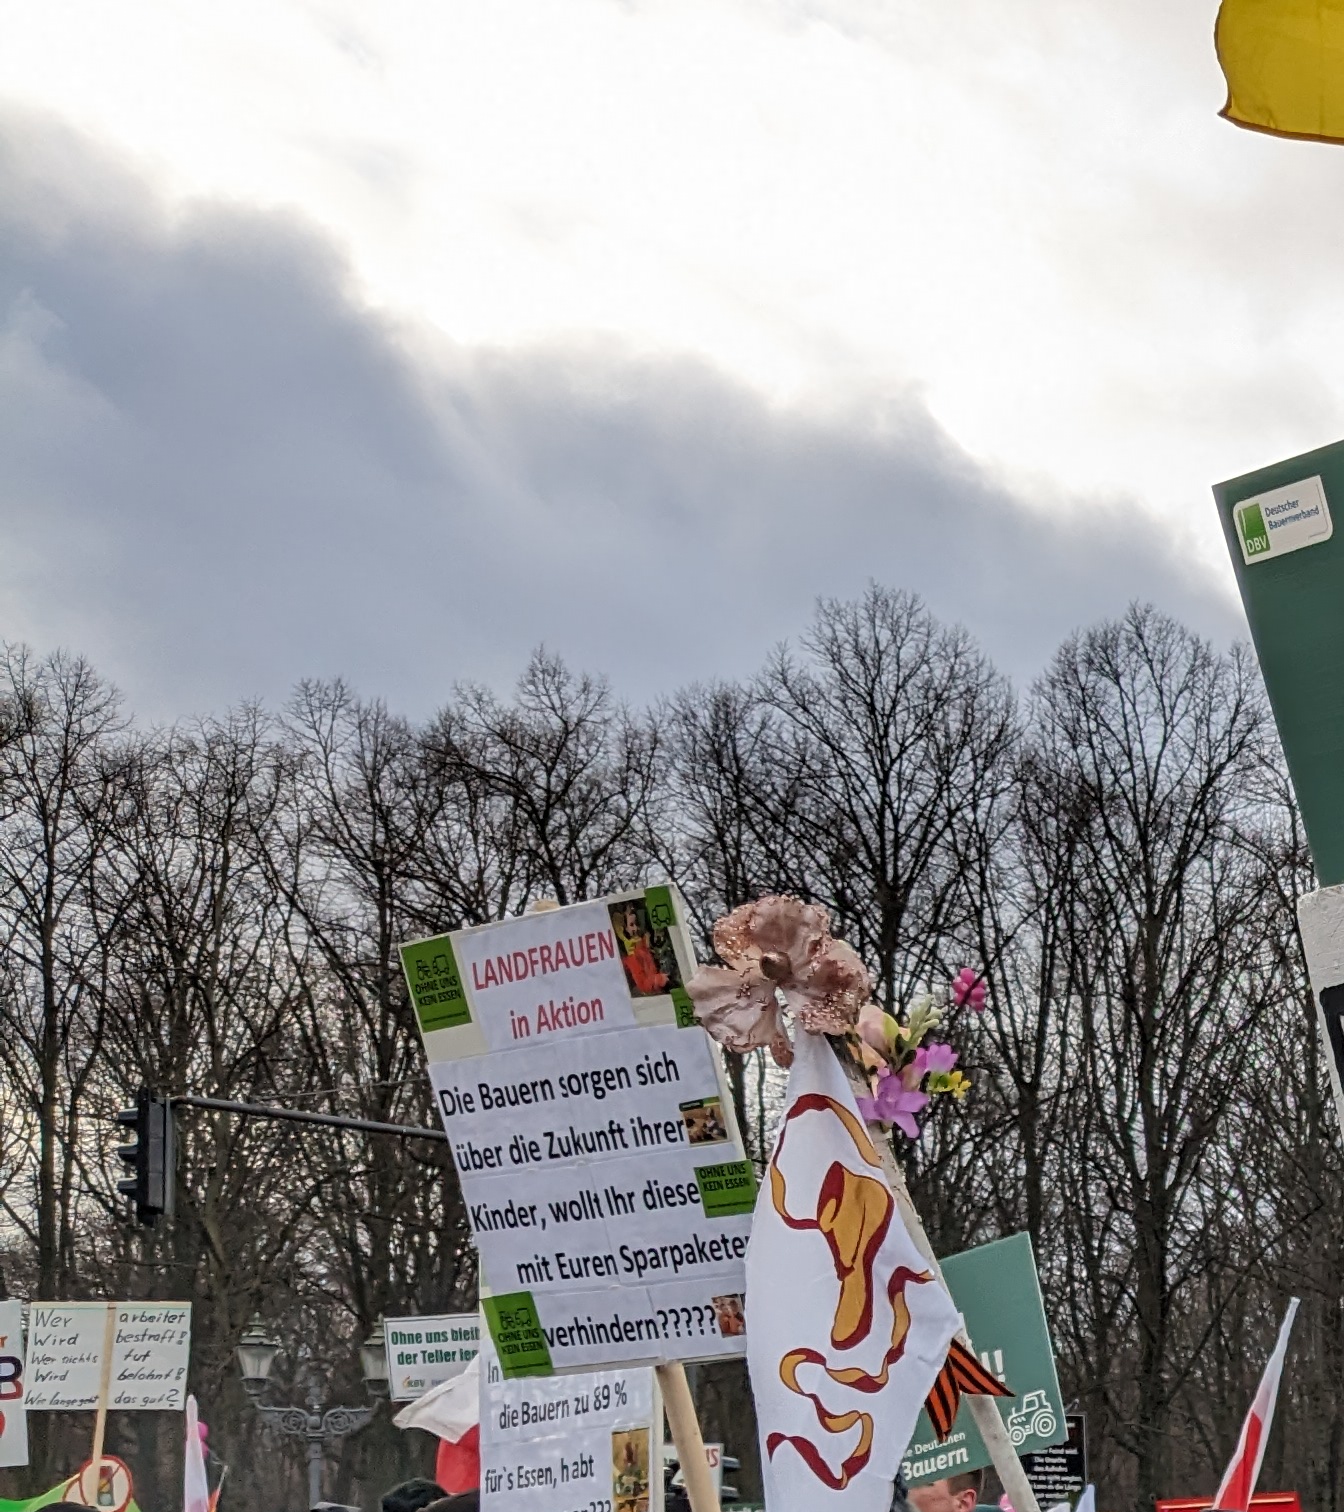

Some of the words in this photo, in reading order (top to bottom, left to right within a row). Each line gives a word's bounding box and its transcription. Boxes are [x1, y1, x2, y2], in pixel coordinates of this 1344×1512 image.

[1265, 500, 1299, 517] Deutscher
[1268, 505, 1320, 530] Bauernverband
[1246, 535, 1267, 553] DBV
[472, 929, 615, 991] LANDFRAUEN
[510, 1010, 528, 1040] in
[536, 996, 604, 1035] Aktion
[439, 1087, 474, 1117] Die
[479, 1076, 555, 1111] Bauern
[560, 1066, 632, 1100] sorgen
[636, 1051, 680, 1086] sich
[456, 1144, 503, 1172] über
[509, 1135, 542, 1164] die
[547, 1119, 626, 1160] Zukunft
[633, 1116, 686, 1147] ihrer
[699, 1166, 726, 1179] OHNE
[727, 1163, 747, 1176] UNS
[471, 1201, 547, 1233] Kinder,
[549, 1190, 604, 1223] wollt
[606, 1187, 636, 1216] Ihr
[642, 1179, 700, 1210] diese
[517, 1258, 553, 1284] mit
[555, 1247, 618, 1280] Euren
[35, 1309, 72, 1328] Wer
[119, 1311, 186, 1324] arbeitet
[542, 1305, 717, 1348] verhindern?????
[34, 1333, 79, 1346] Wird
[391, 1331, 422, 1346] Ohne
[425, 1331, 448, 1344] uns
[31, 1352, 57, 1365] Wer
[62, 1352, 99, 1365] nichts
[123, 1349, 152, 1363] tut
[397, 1351, 418, 1365] der
[421, 1349, 457, 1364] Teller
[114, 1390, 136, 1405] das
[141, 1388, 180, 1408] gut?
[500, 1407, 519, 1430] die
[521, 1397, 569, 1425] Bauern
[574, 1394, 589, 1414] zu
[593, 1385, 611, 1410] 89
[614, 1380, 628, 1406] %
[915, 1433, 966, 1455] Deuthen
[517, 1462, 557, 1490] Essen,
[902, 1447, 969, 1481] Bauern
